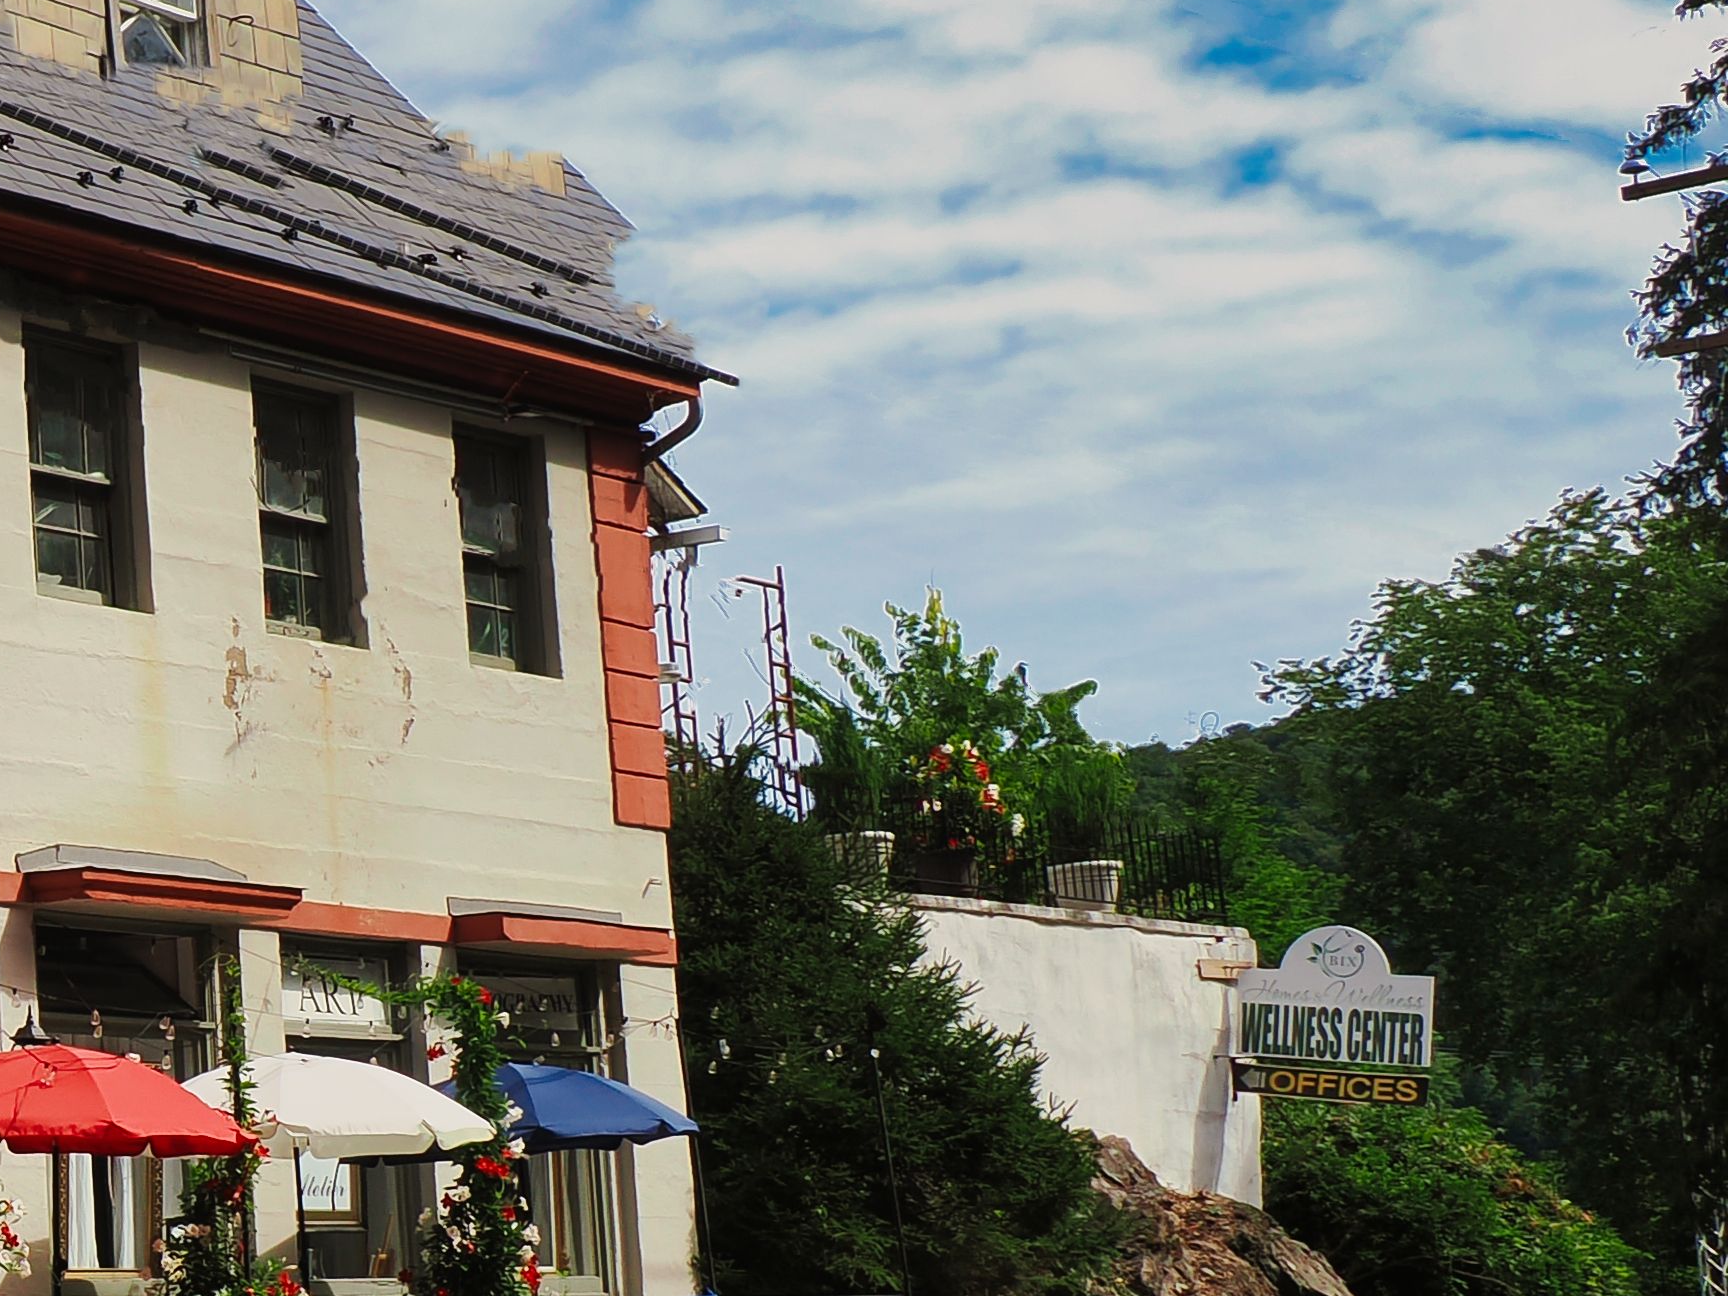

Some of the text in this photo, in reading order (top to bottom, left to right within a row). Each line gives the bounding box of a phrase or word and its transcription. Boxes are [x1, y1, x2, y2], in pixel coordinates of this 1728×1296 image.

[299, 973, 573, 1016] ART OGRAPHY
[1244, 979, 1310, 1002] Homes
[1324, 980, 1424, 1010] Wellness
[1241, 1002, 1424, 1066] WELLNESS CENTER
[1268, 1070, 1419, 1102] OFFICES
[302, 1172, 345, 1197] telir
